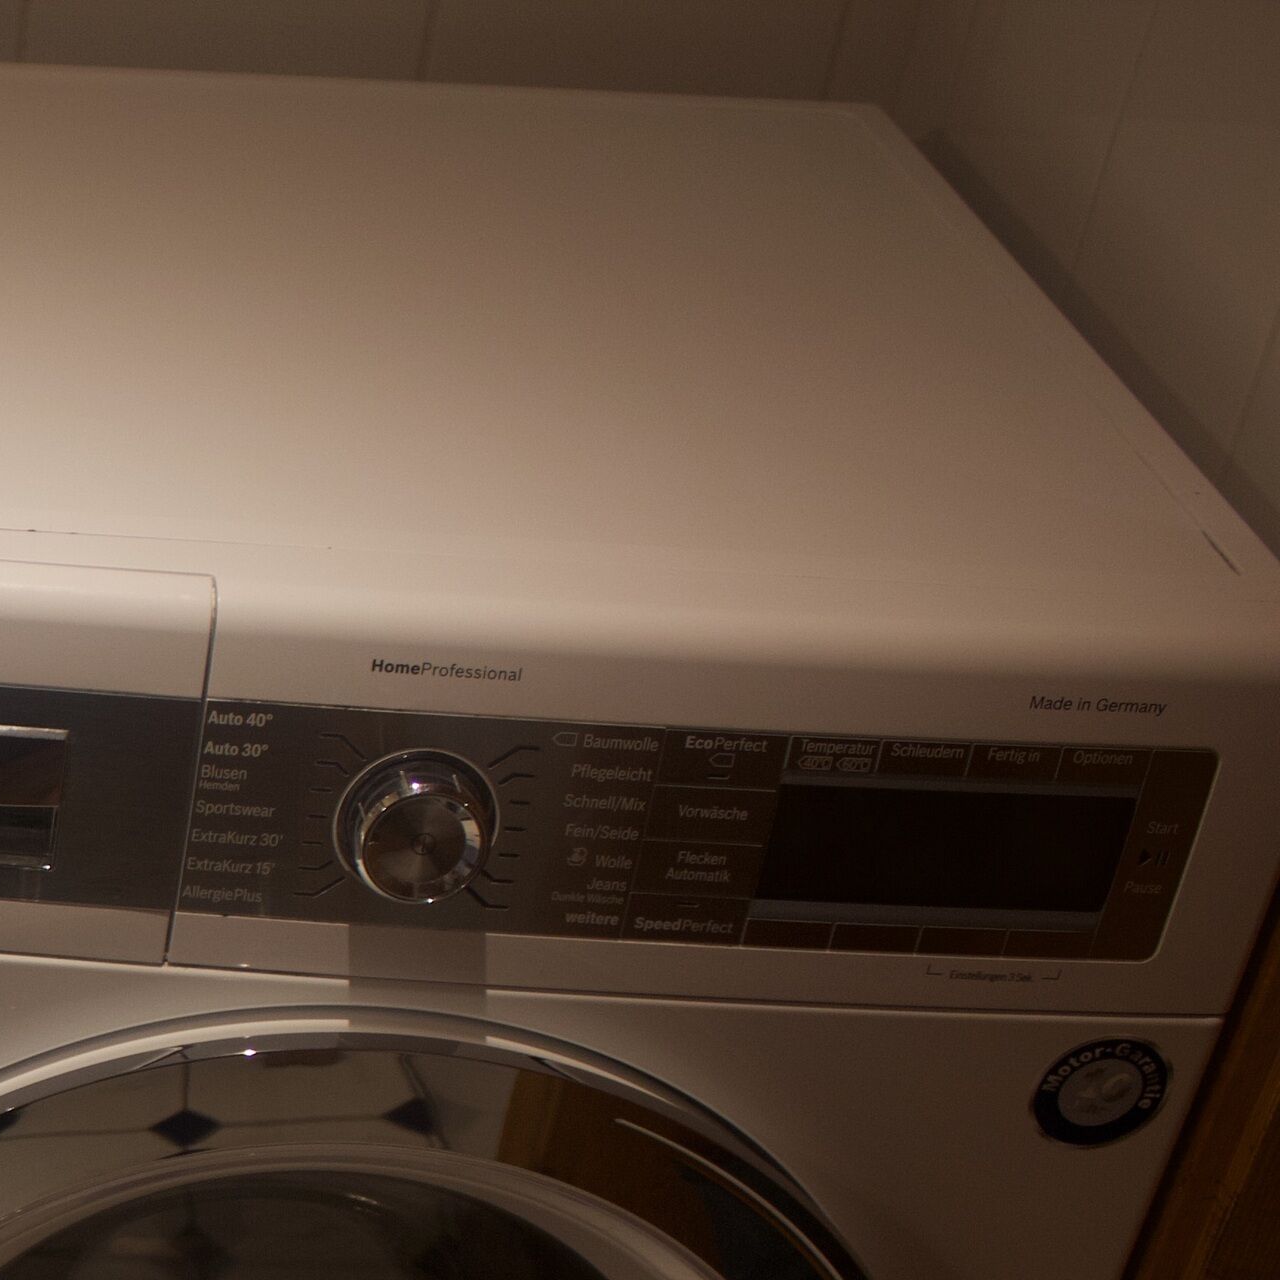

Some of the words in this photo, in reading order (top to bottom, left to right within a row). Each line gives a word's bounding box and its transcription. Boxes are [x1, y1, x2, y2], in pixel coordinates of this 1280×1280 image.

[371, 659, 522, 681] HomeProfessional
[1029, 696, 1073, 711] Made
[1077, 697, 1091, 711] in
[1096, 698, 1167, 717] Germany
[208, 710, 243, 726] Auto
[246, 713, 274, 727] 40°
[204, 741, 238, 756] Auto
[241, 744, 269, 758] 30°
[583, 734, 659, 751] Baumwolle
[684, 736, 768, 753] EcoPerfect
[801, 739, 876, 755] Temperatur
[890, 742, 965, 759] Schleudern
[987, 747, 1026, 765] Fertig
[1027, 749, 1041, 763] in
[1073, 750, 1133, 766] Optionen
[201, 765, 247, 780] Blusen
[571, 763, 653, 783] Pflegeleicht
[199, 780, 240, 792] Hemden
[195, 800, 276, 817] Sportswear
[563, 793, 647, 812] Schnell/Mix
[678, 804, 749, 822] Vorwäsche
[565, 823, 639, 841] Fein/Seide
[1146, 820, 1180, 835] Start
[192, 828, 258, 845] ExtraKurz
[187, 857, 252, 874] ExtraKurz
[595, 855, 632, 870] Wolle
[677, 850, 727, 865] Flecken
[665, 867, 731, 883] Automatik
[587, 878, 627, 892] Jeans
[1124, 880, 1163, 895] Pause
[182, 885, 263, 903] AllergiePlus
[565, 911, 620, 926] weitere
[634, 917, 734, 934] SpeedPerfect
[1041, 1042, 1163, 1110] Motor-Garantie
